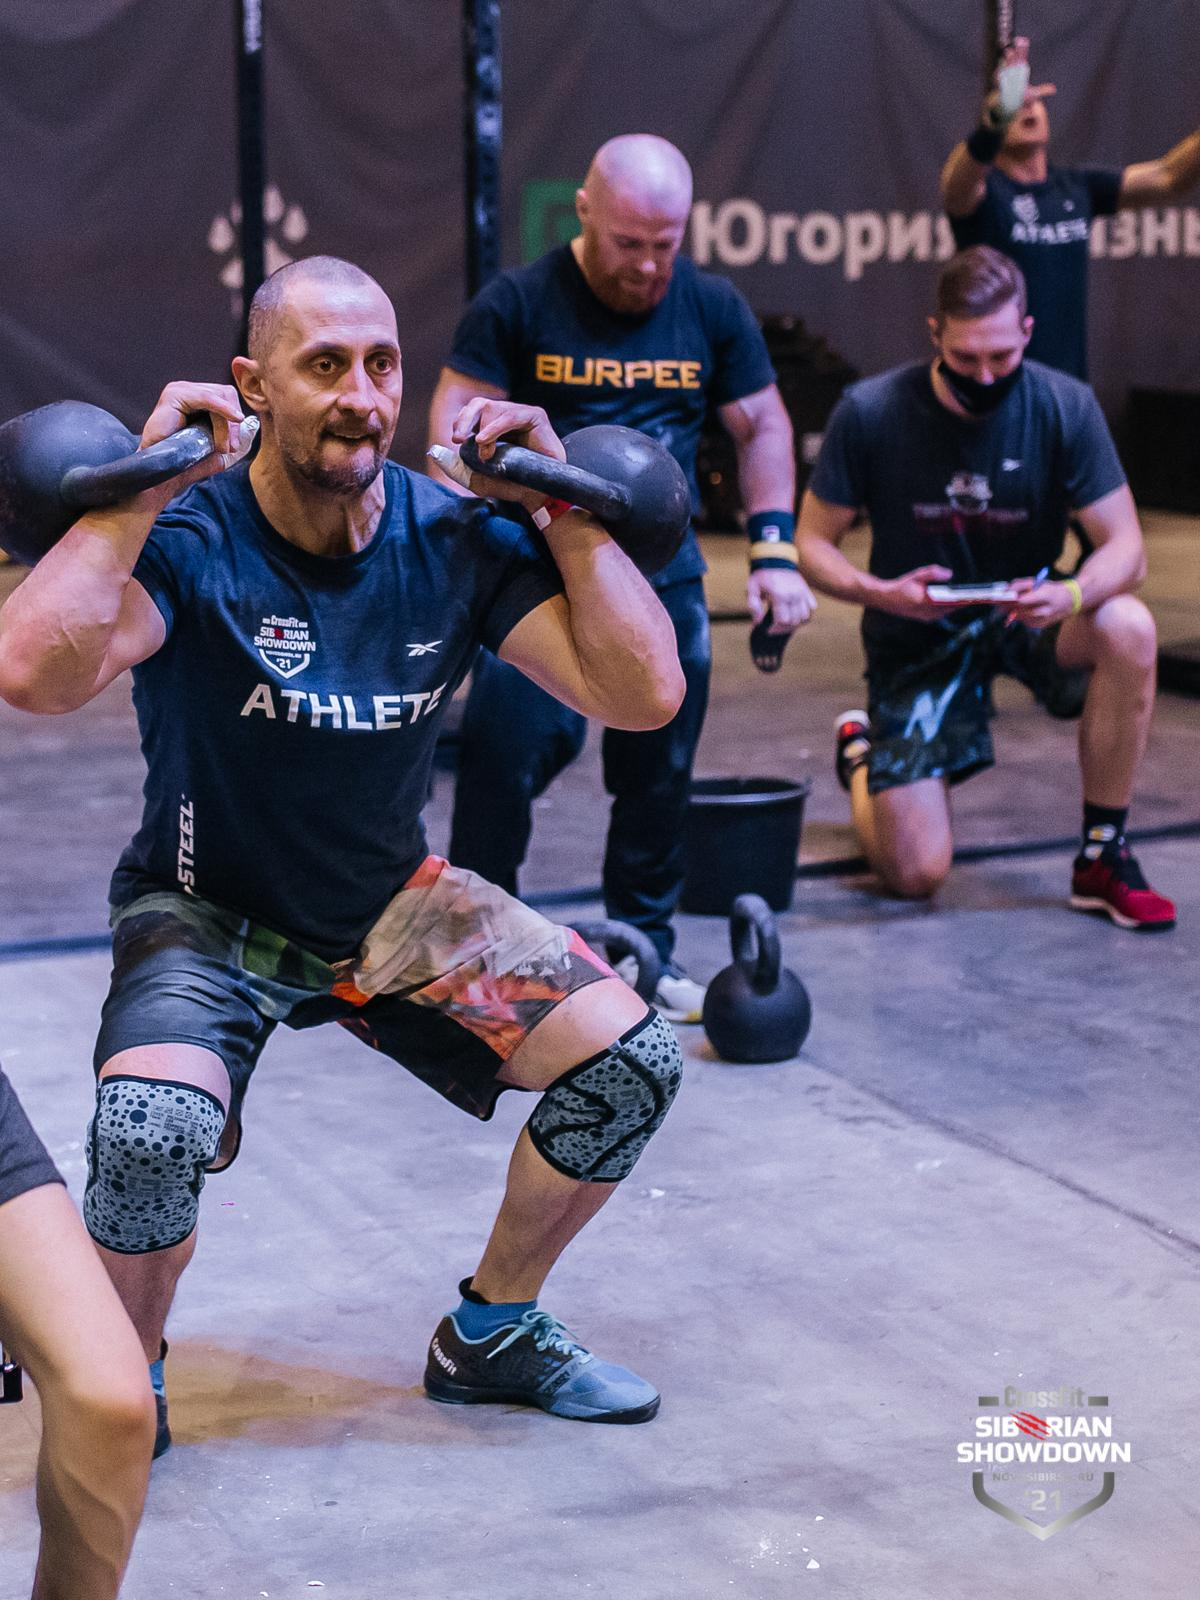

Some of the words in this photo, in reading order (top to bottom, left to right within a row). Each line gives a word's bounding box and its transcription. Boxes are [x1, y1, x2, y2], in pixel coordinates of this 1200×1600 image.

[536, 354, 702, 389] BURPEE
[254, 636, 316, 651] SHOWDOWN
[260, 626, 309, 640] SIBRIAN
[177, 801, 195, 895] STEEL
